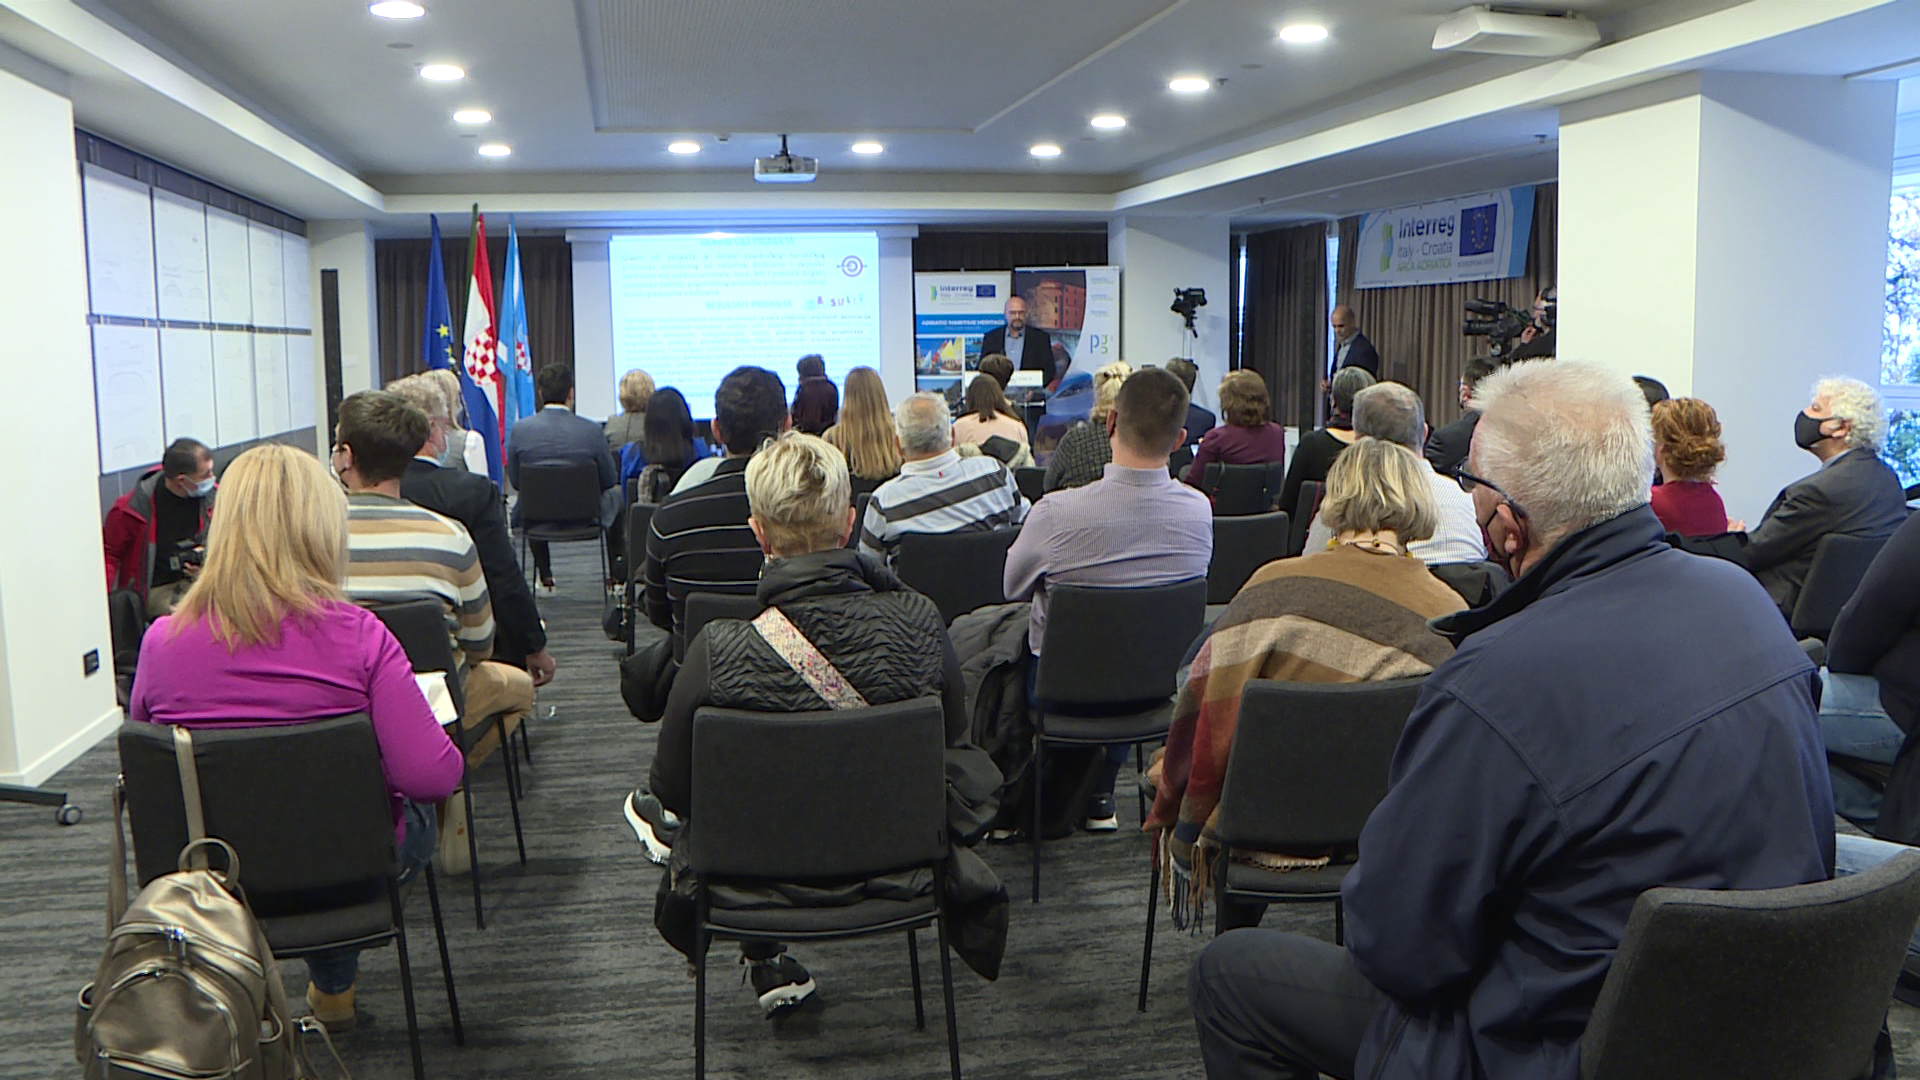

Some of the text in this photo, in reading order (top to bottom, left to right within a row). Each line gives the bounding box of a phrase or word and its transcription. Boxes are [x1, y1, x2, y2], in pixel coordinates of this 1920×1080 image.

[1399, 216, 1455, 239] Interreg
[1398, 244, 1414, 261] Italy
[1422, 241, 1453, 256] Croatia
[940, 284, 974, 292] Interreg
